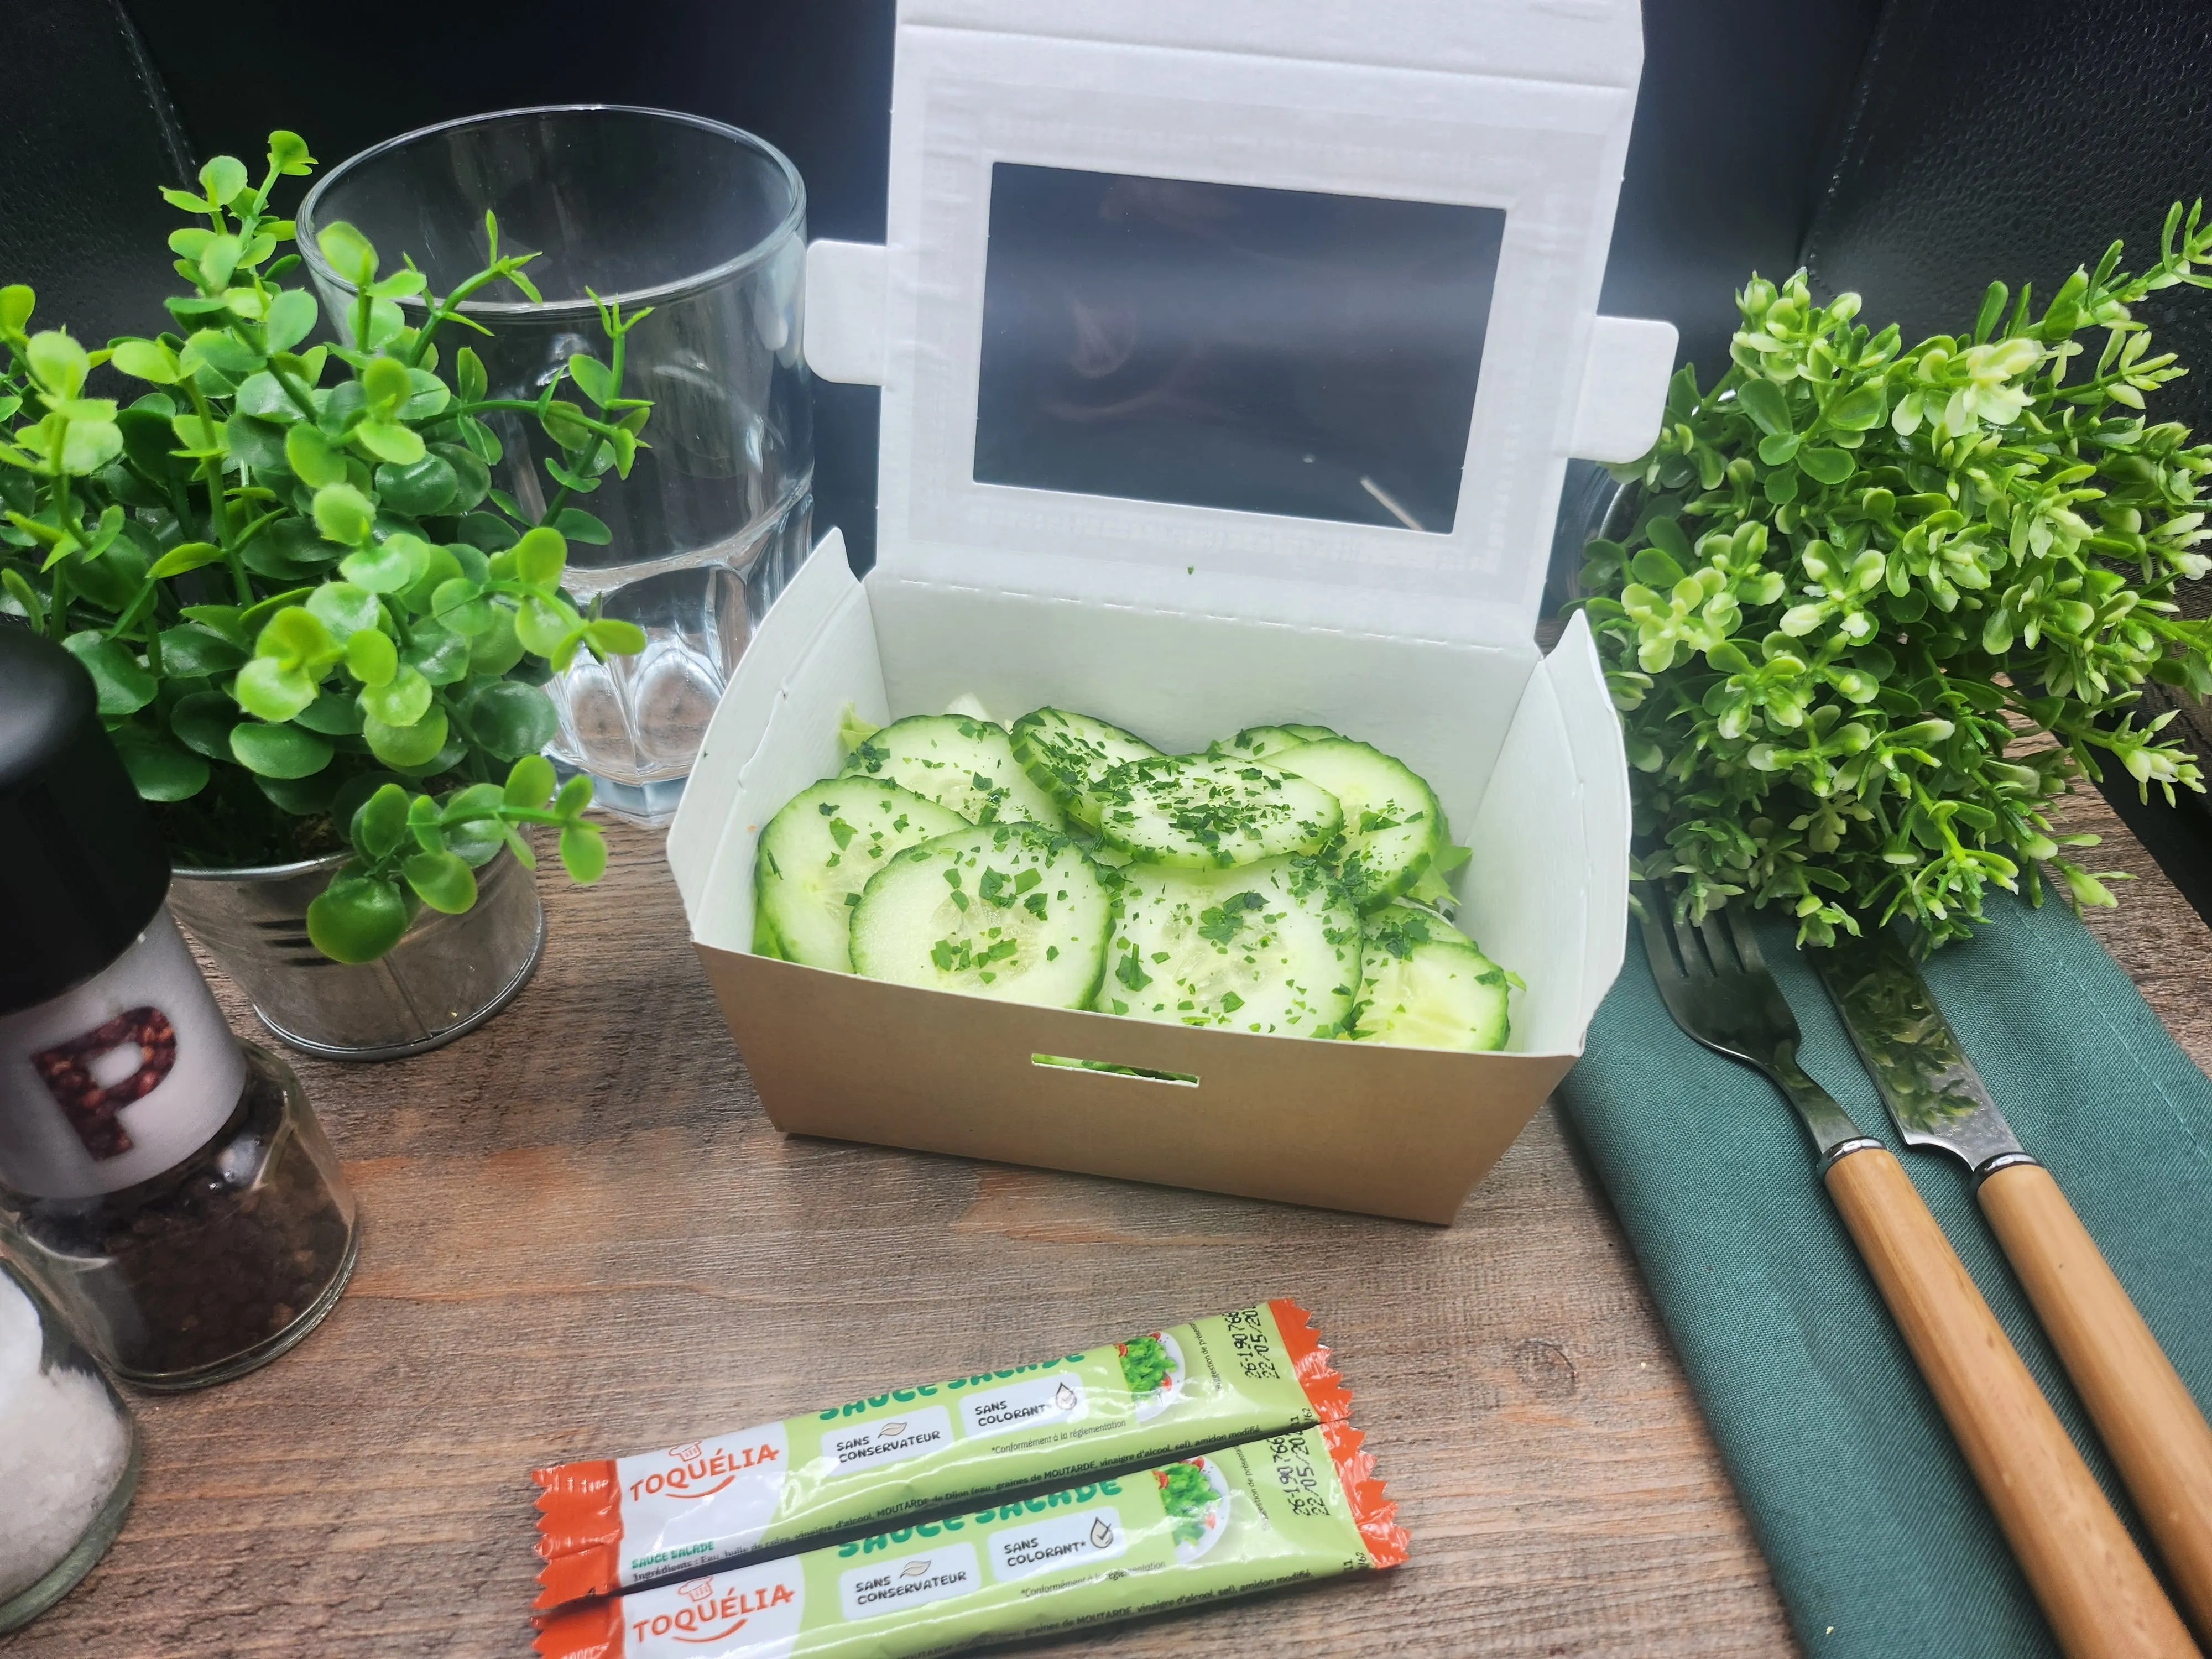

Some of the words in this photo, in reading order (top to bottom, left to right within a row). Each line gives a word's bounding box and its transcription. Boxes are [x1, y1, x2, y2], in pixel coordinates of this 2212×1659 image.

[30, 1006, 176, 1161] P
[1242, 1306, 1280, 1379] 22/05/20
[975, 1400, 1008, 1416] SANS
[836, 1436, 870, 1452] SANS
[1053, 1433, 1059, 1441] à
[1070, 1420, 1126, 1438] réglementation
[838, 1431, 941, 1464] CONSERVATEUR
[1030, 1473, 1042, 1483] de
[1194, 1433, 1227, 1447] amidon
[630, 1443, 780, 1501] TOQUÉLIA
[631, 1551, 669, 1569] SAUCE
[671, 1541, 715, 1559] SALADE
[1003, 1537, 1039, 1554] SANS
[855, 1575, 891, 1593] SANS
[857, 1571, 968, 1604] CONSERVATEUR
[633, 1584, 795, 1642] TOQUÉLIA
